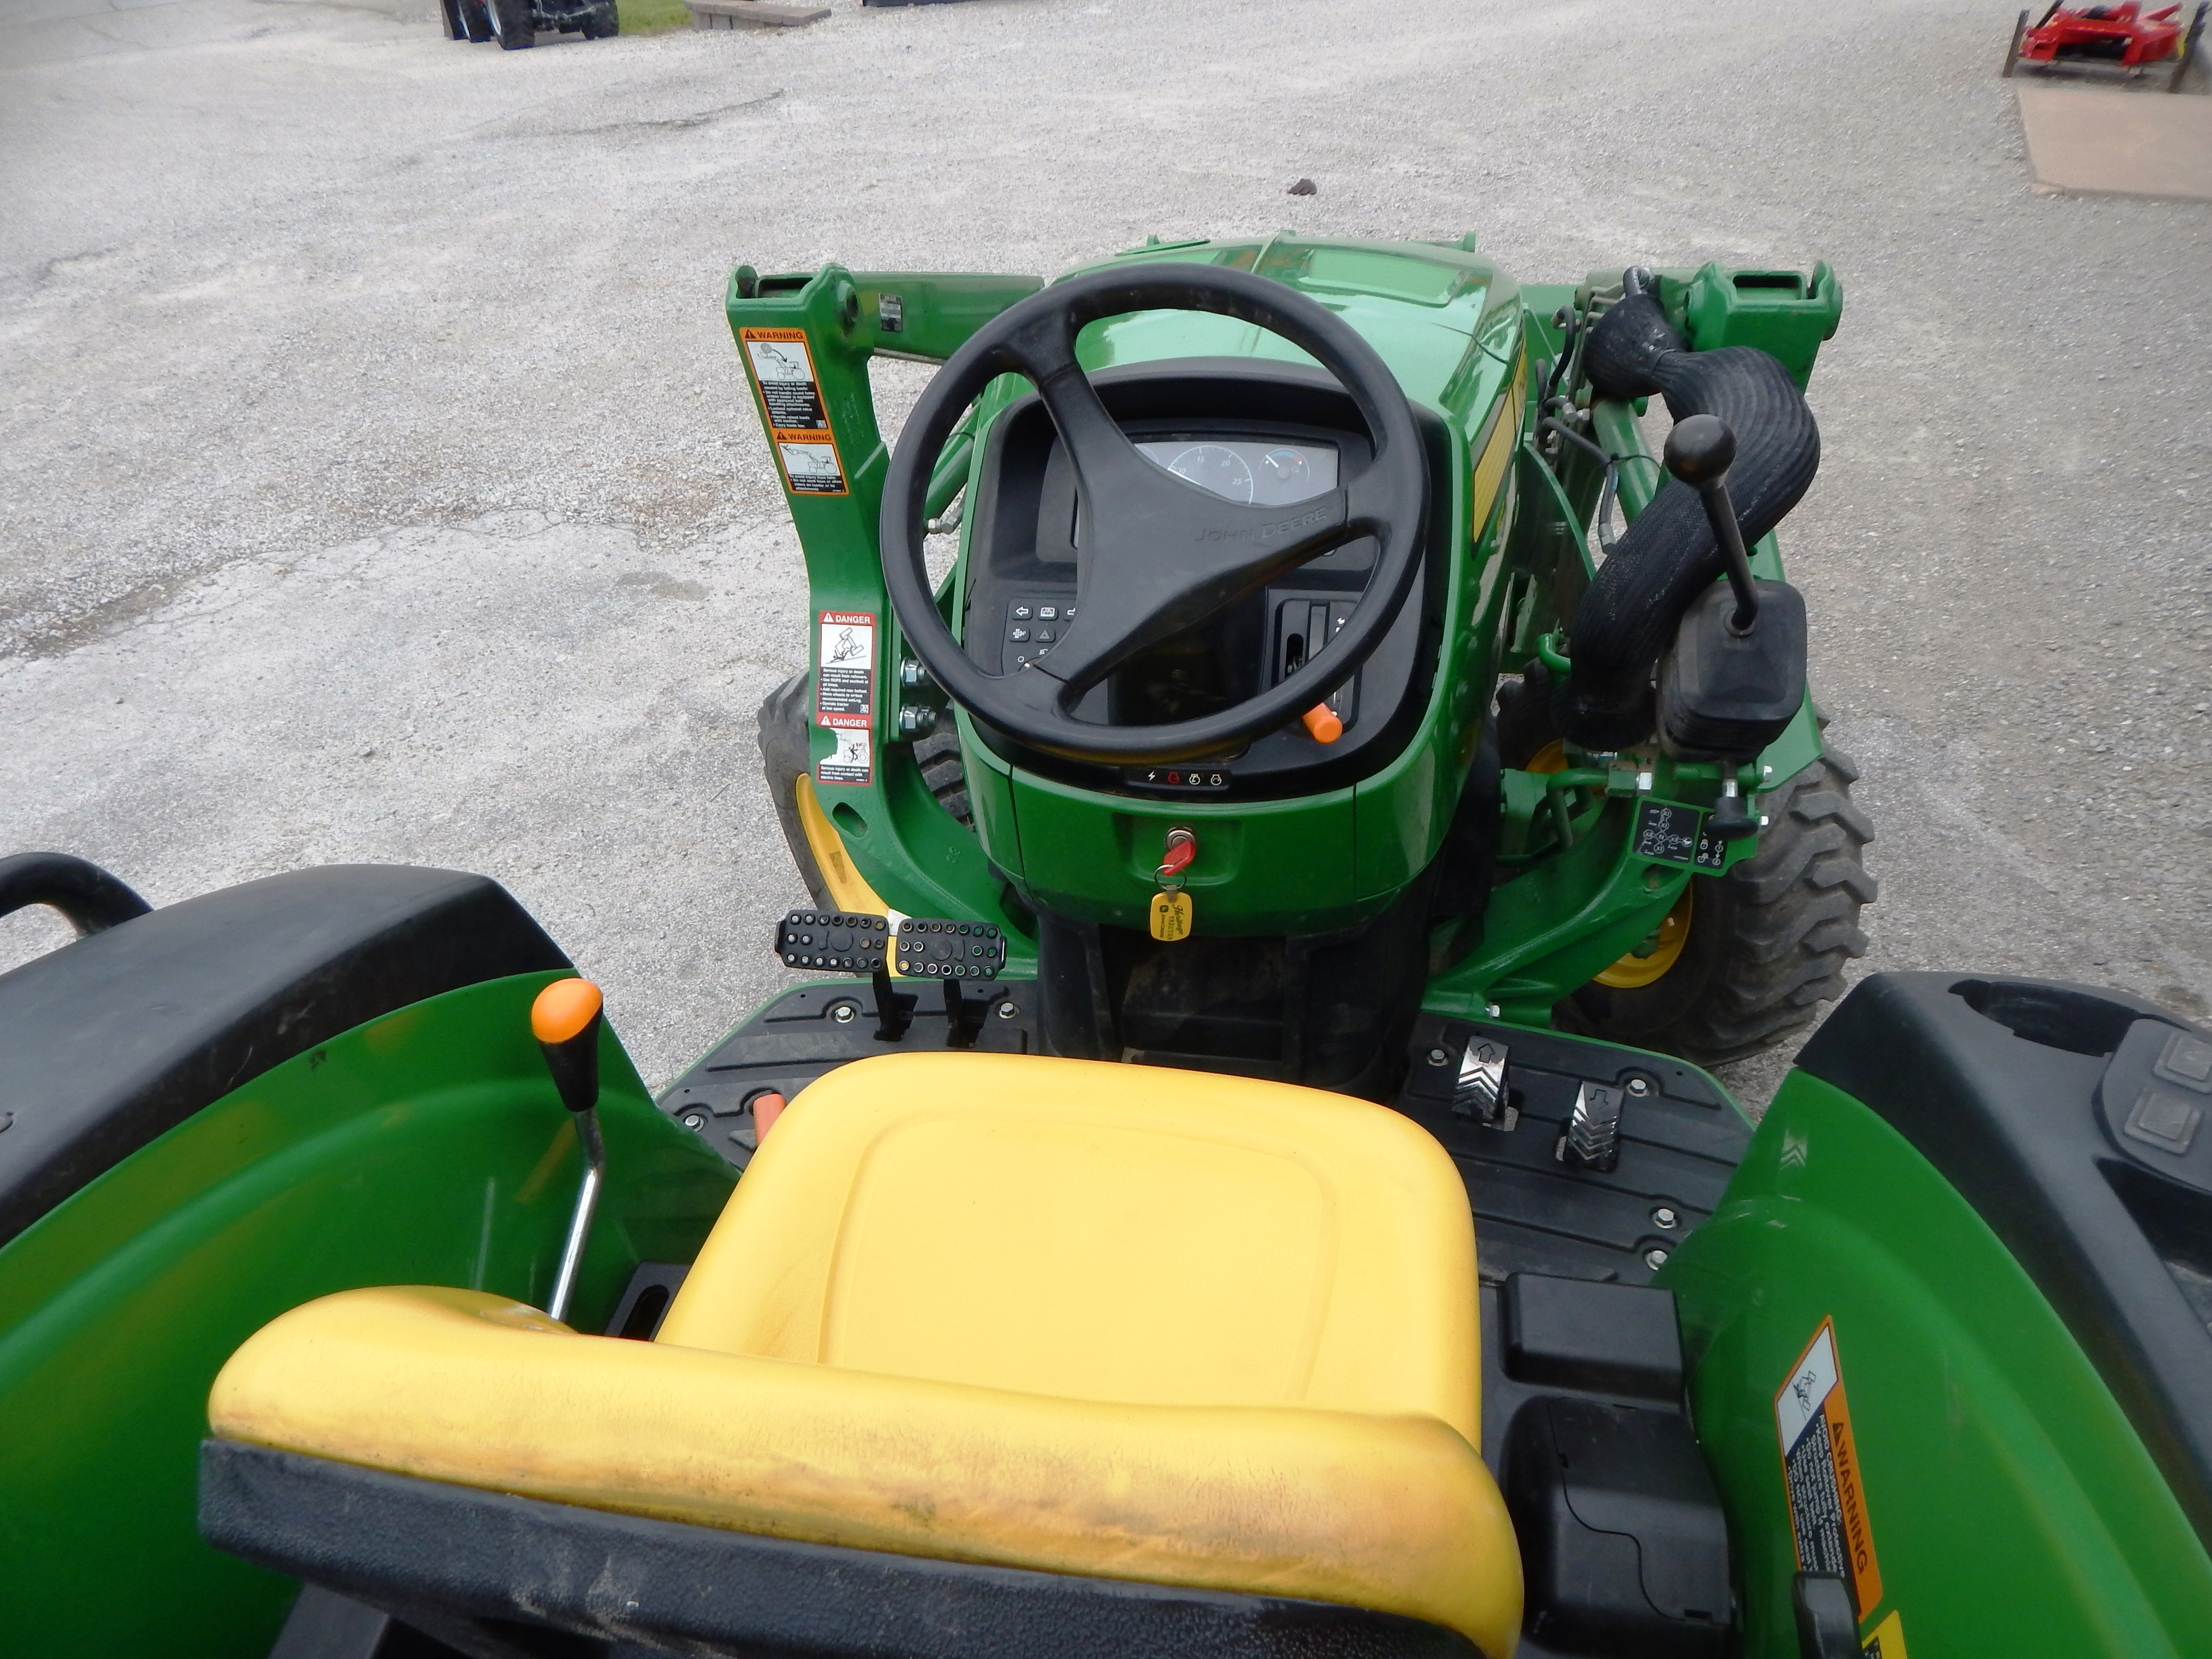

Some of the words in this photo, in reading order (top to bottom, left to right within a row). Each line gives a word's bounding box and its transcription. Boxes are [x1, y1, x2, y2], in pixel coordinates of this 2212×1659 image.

[757, 331, 804, 339] WARNING
[788, 433, 832, 441] WARNING
[1262, 507, 1327, 538] DEERE
[835, 614, 871, 624] DANGER
[833, 718, 867, 727] DANGER
[1819, 1414, 1829, 1450] AVOID
[1837, 1442, 1868, 1575] WARNING
